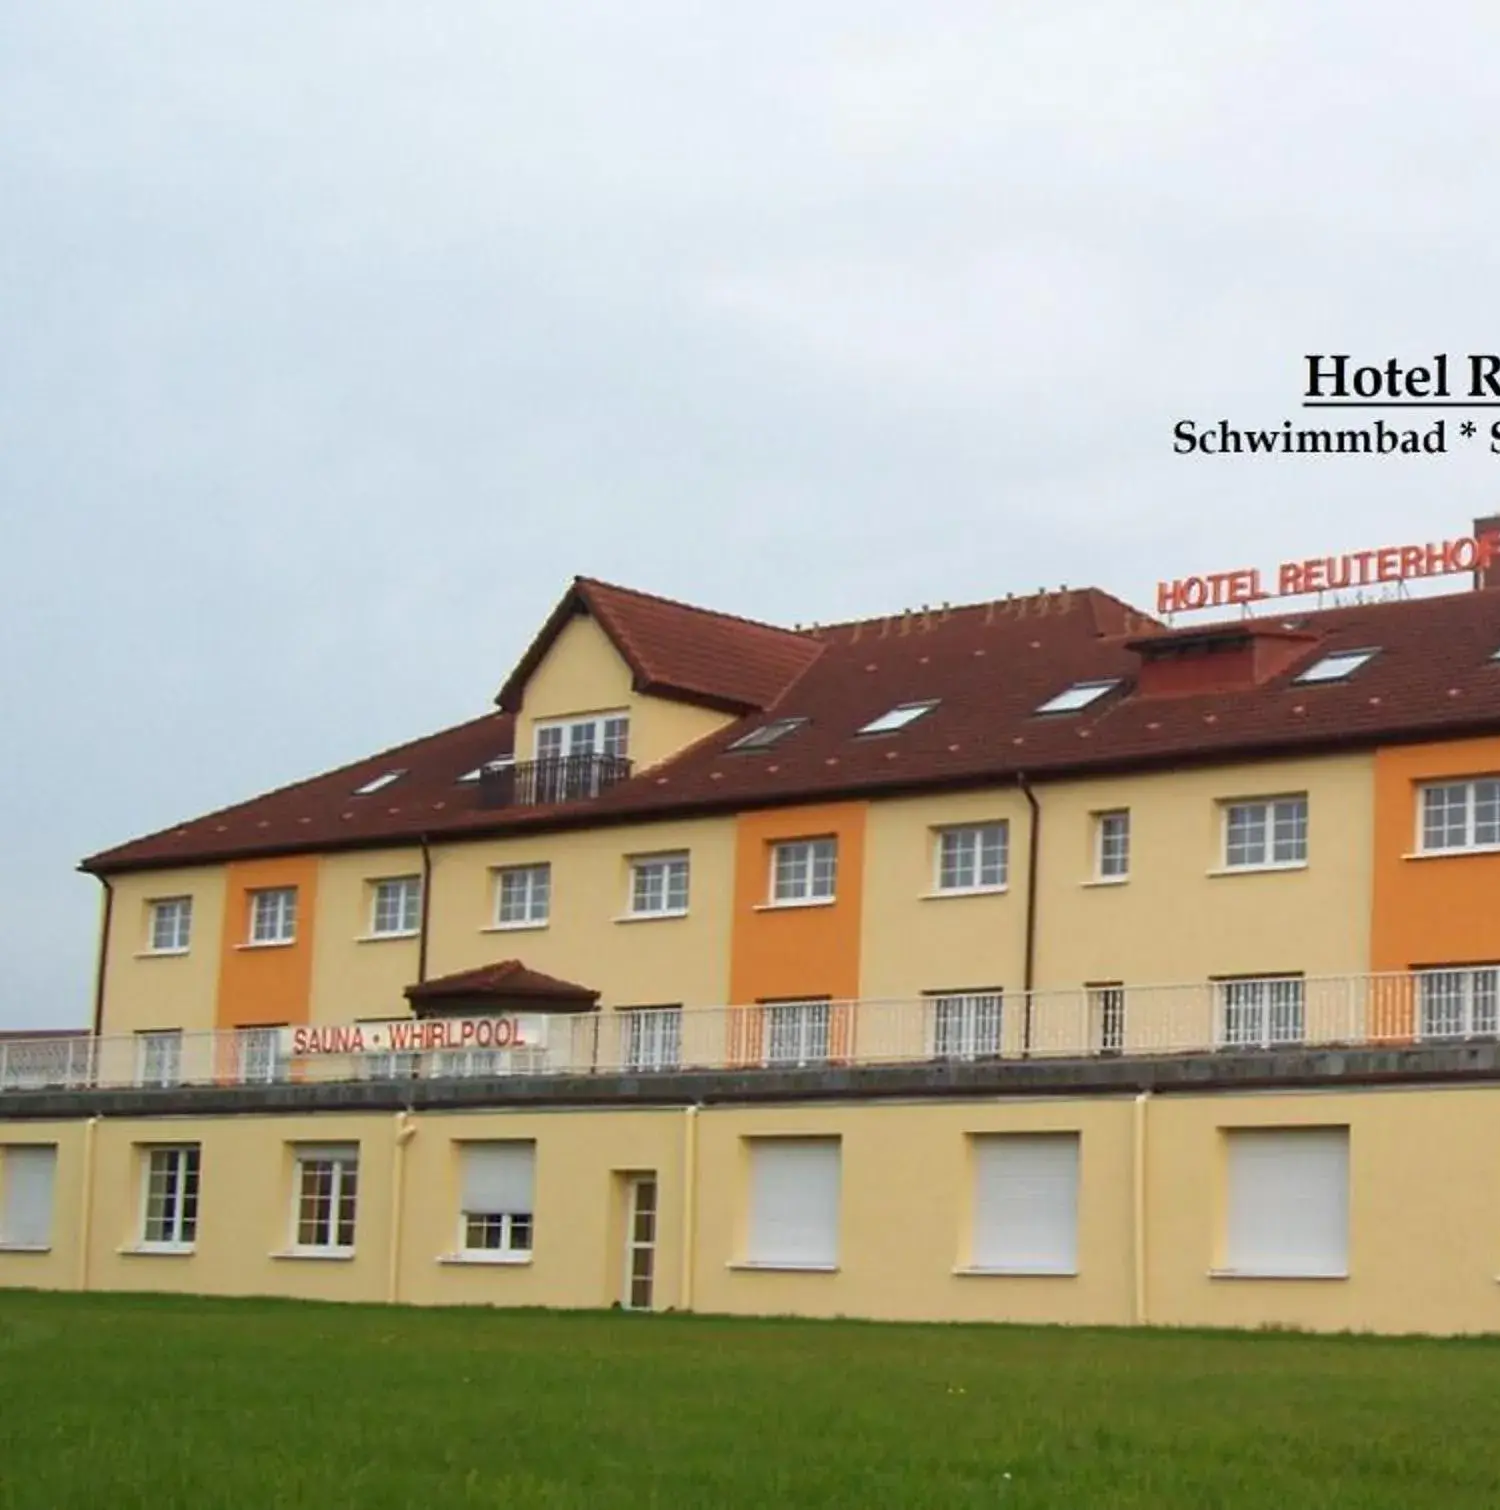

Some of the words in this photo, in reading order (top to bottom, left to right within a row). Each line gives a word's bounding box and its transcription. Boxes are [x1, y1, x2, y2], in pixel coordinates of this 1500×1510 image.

[1156, 567, 1267, 615] HOTEL
[293, 1025, 364, 1054] SAUNA
[389, 1017, 525, 1050] WHIRLPOOL
